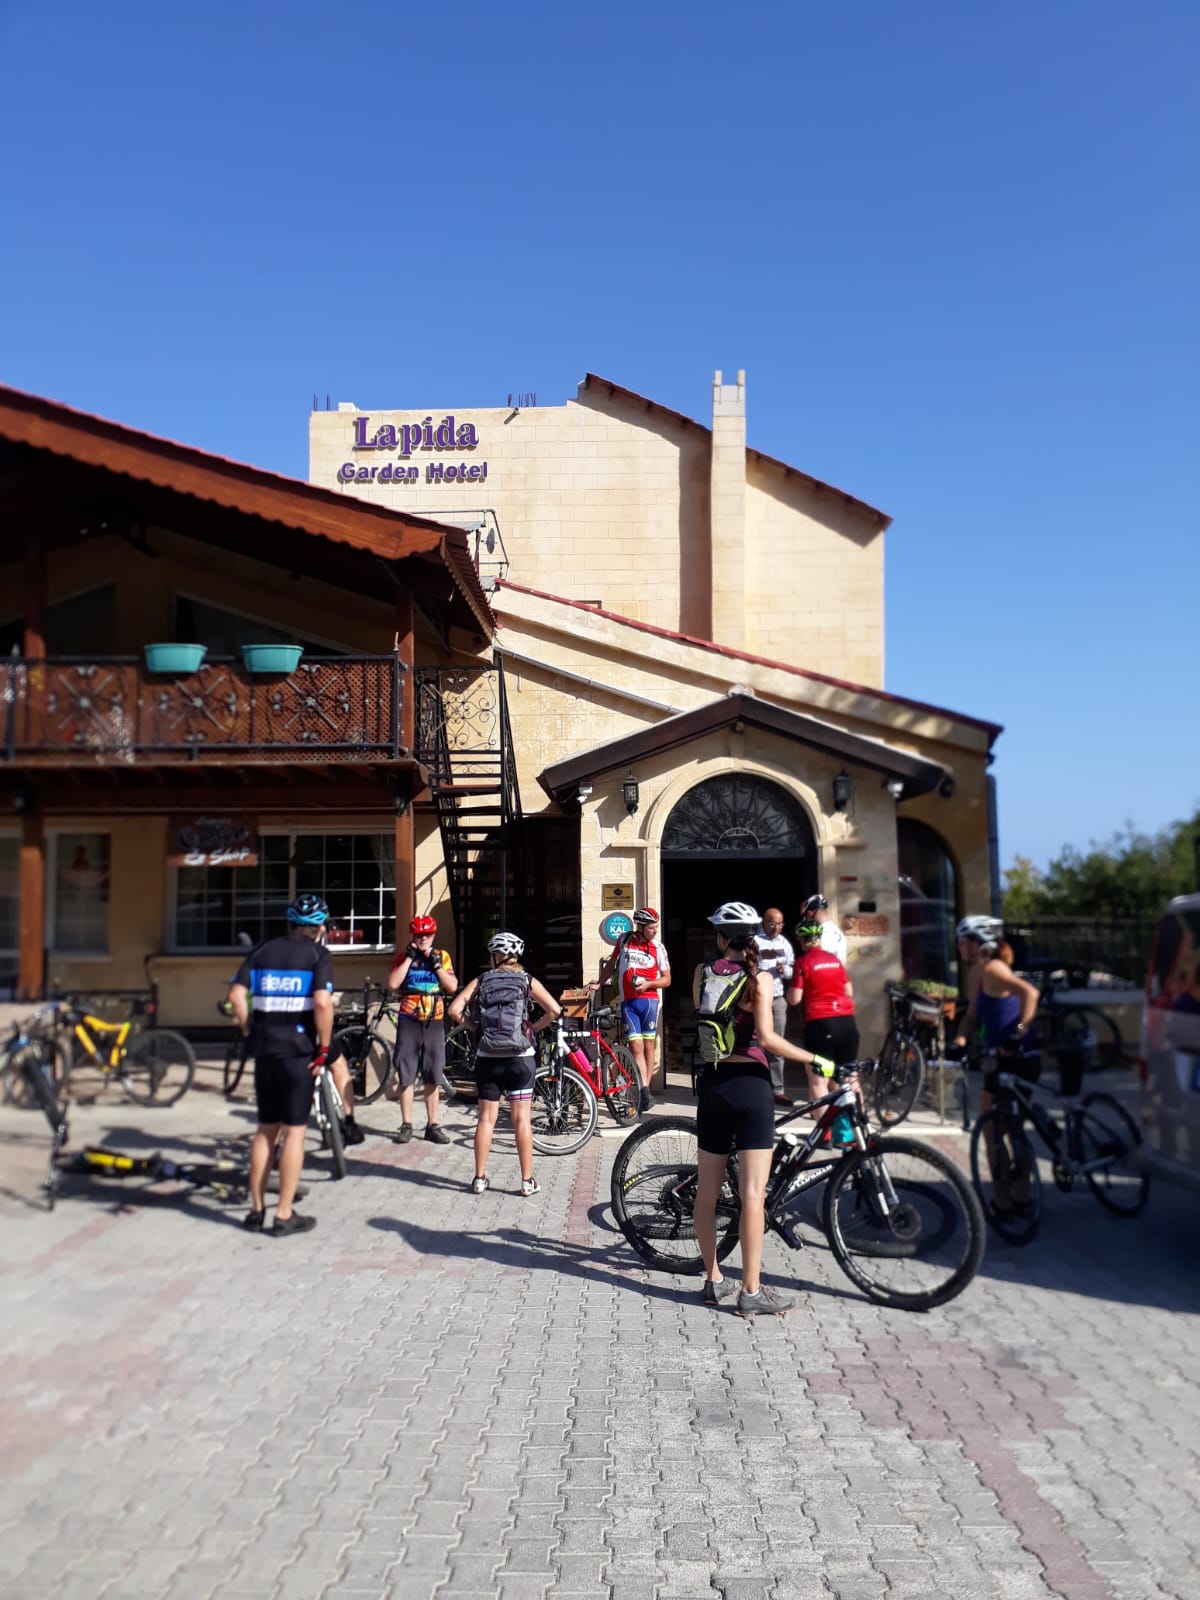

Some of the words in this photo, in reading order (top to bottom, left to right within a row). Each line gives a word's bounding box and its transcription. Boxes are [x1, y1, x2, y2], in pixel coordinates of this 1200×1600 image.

[355, 415, 480, 456] Lapida
[340, 462, 419, 480] Garden
[429, 461, 488, 479] Hotel
[260, 974, 302, 992] eleven
